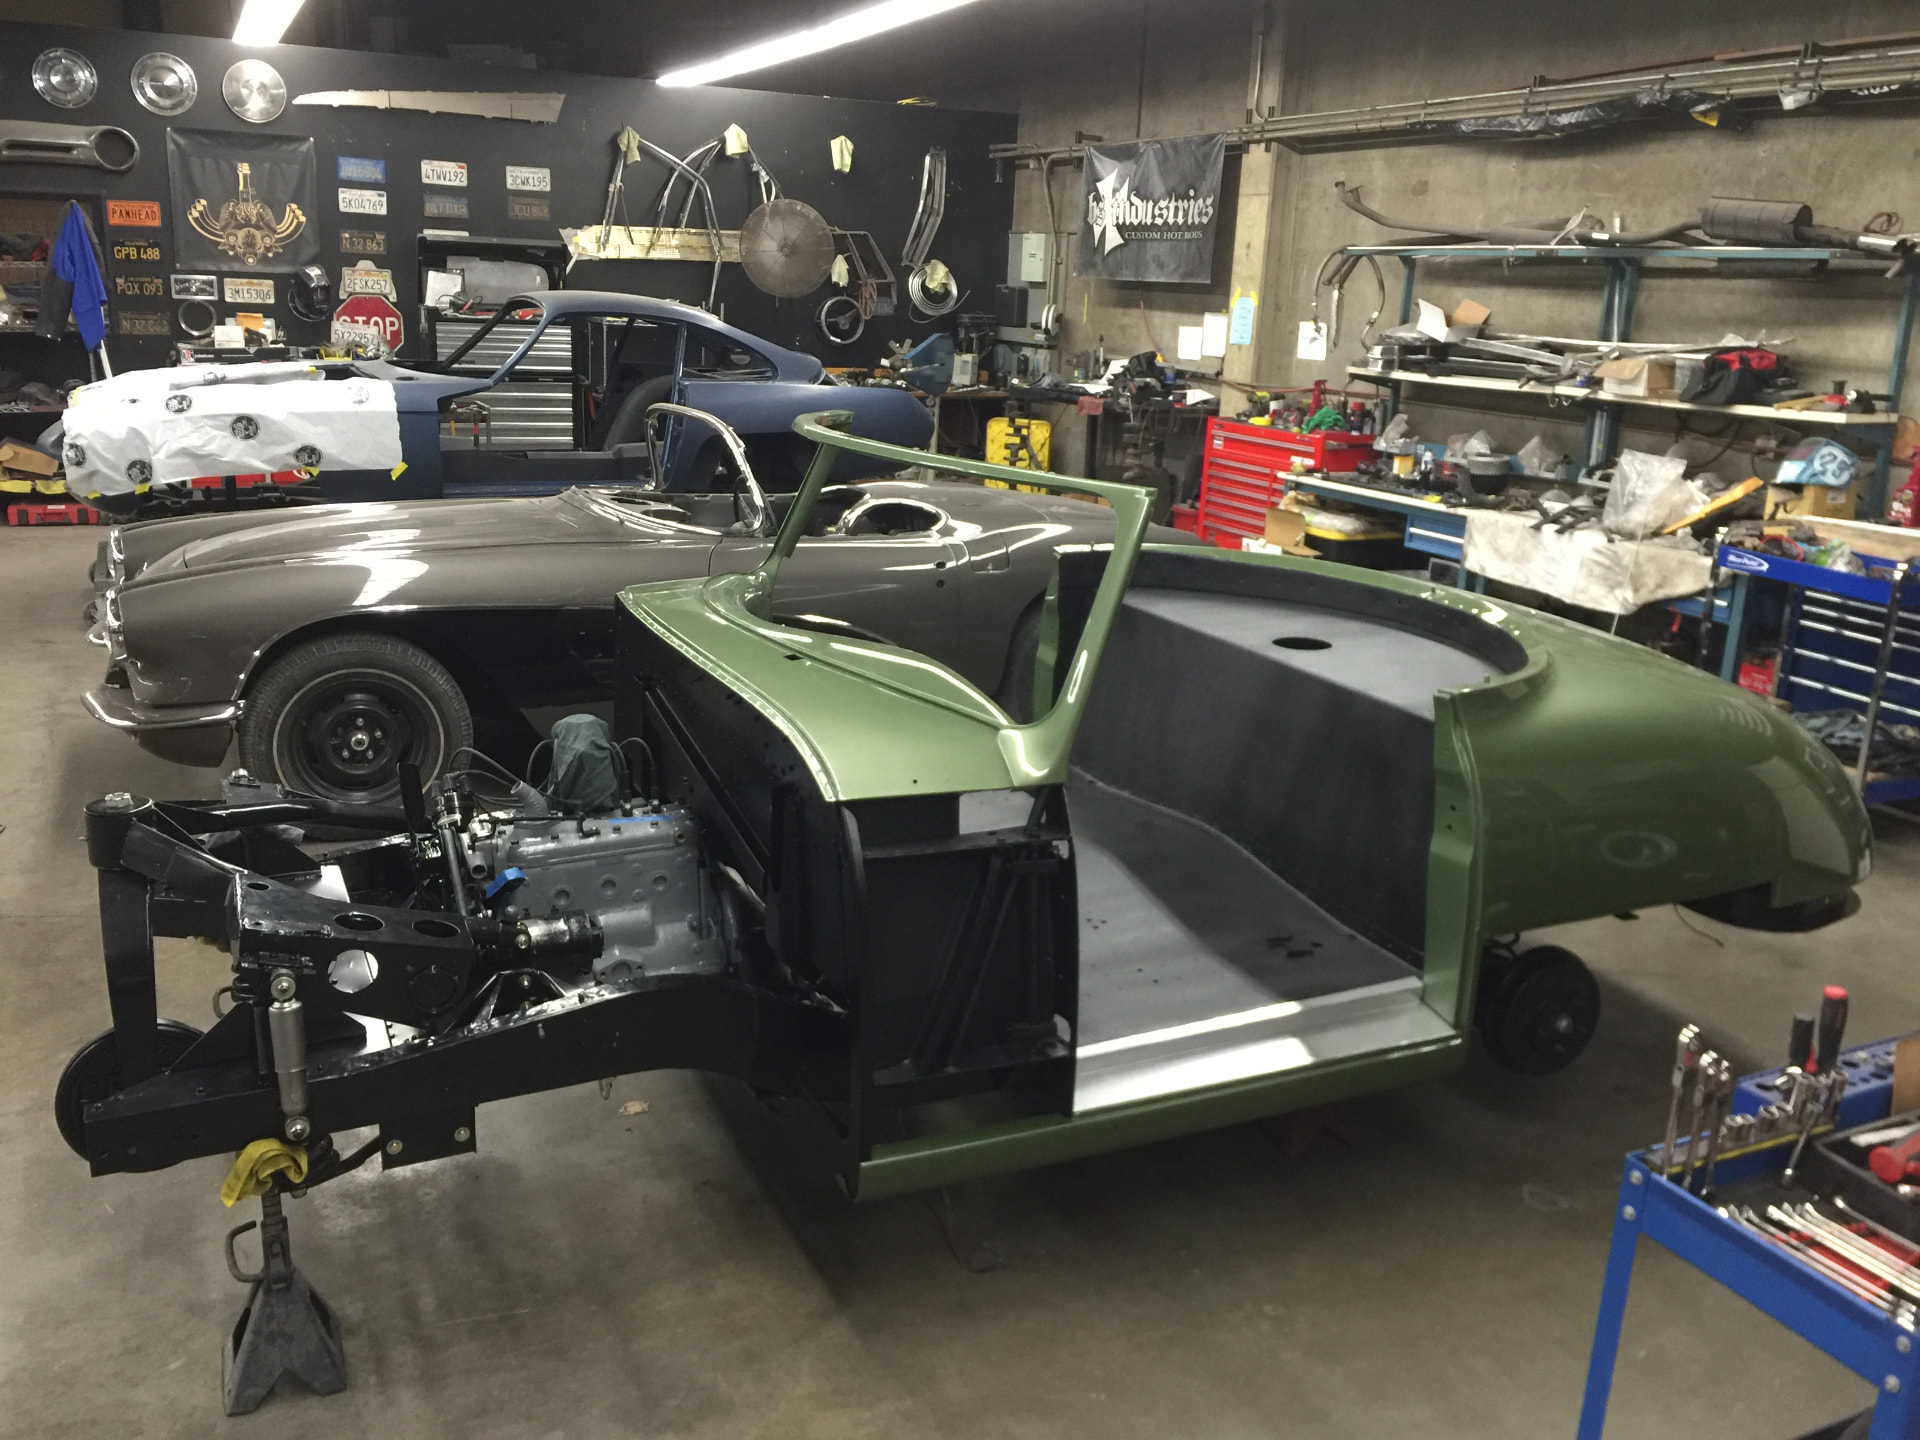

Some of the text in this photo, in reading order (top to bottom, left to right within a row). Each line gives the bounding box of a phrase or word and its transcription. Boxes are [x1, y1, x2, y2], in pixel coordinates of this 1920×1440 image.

[424, 168, 465, 183] 4TWV192
[509, 174, 548, 188] 3CWK195
[111, 207, 157, 221] PANHEAD
[1125, 231, 1161, 240] CUSTOM
[1163, 231, 1185, 240] HOT
[342, 238, 350, 249] N
[113, 246, 160, 260] GPB 488
[117, 282, 141, 295] PQX
[143, 283, 163, 296] 093
